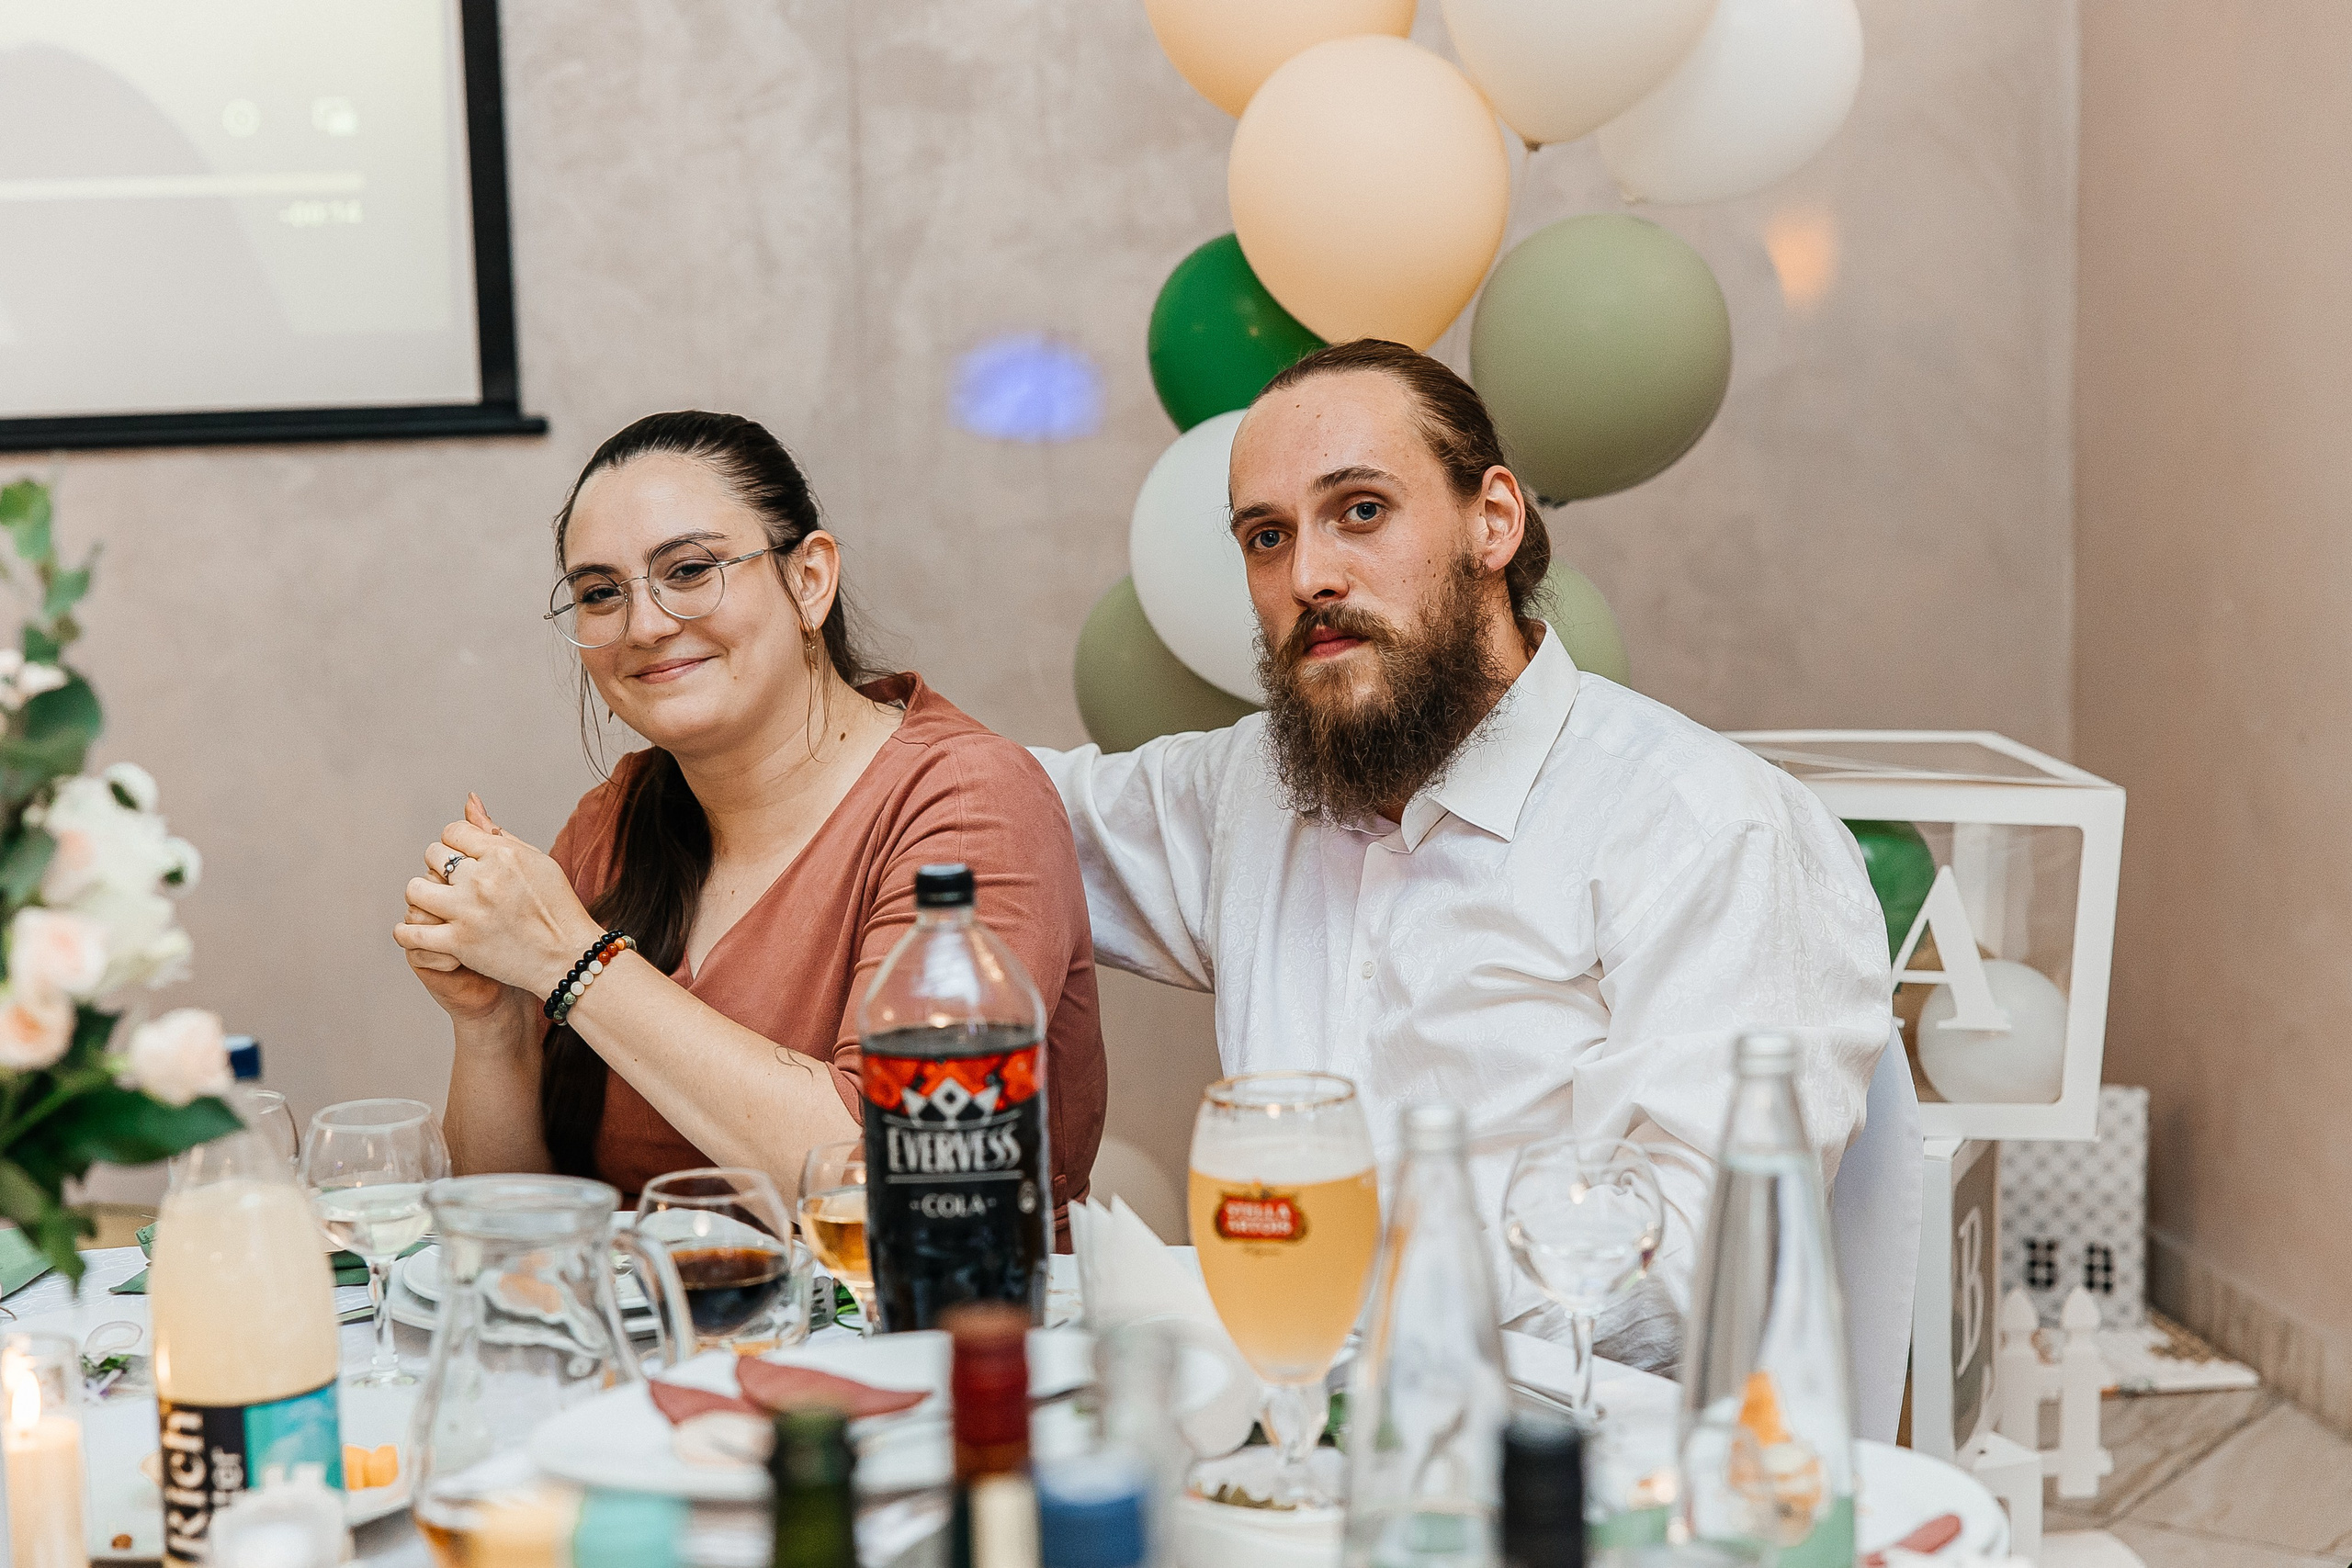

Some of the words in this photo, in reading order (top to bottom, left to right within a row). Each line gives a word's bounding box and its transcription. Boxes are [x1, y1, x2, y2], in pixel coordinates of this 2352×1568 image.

[1891, 864, 2012, 1032] A
[886, 1122, 1022, 1173] EVERVESS
[921, 1193, 988, 1219] COLA
